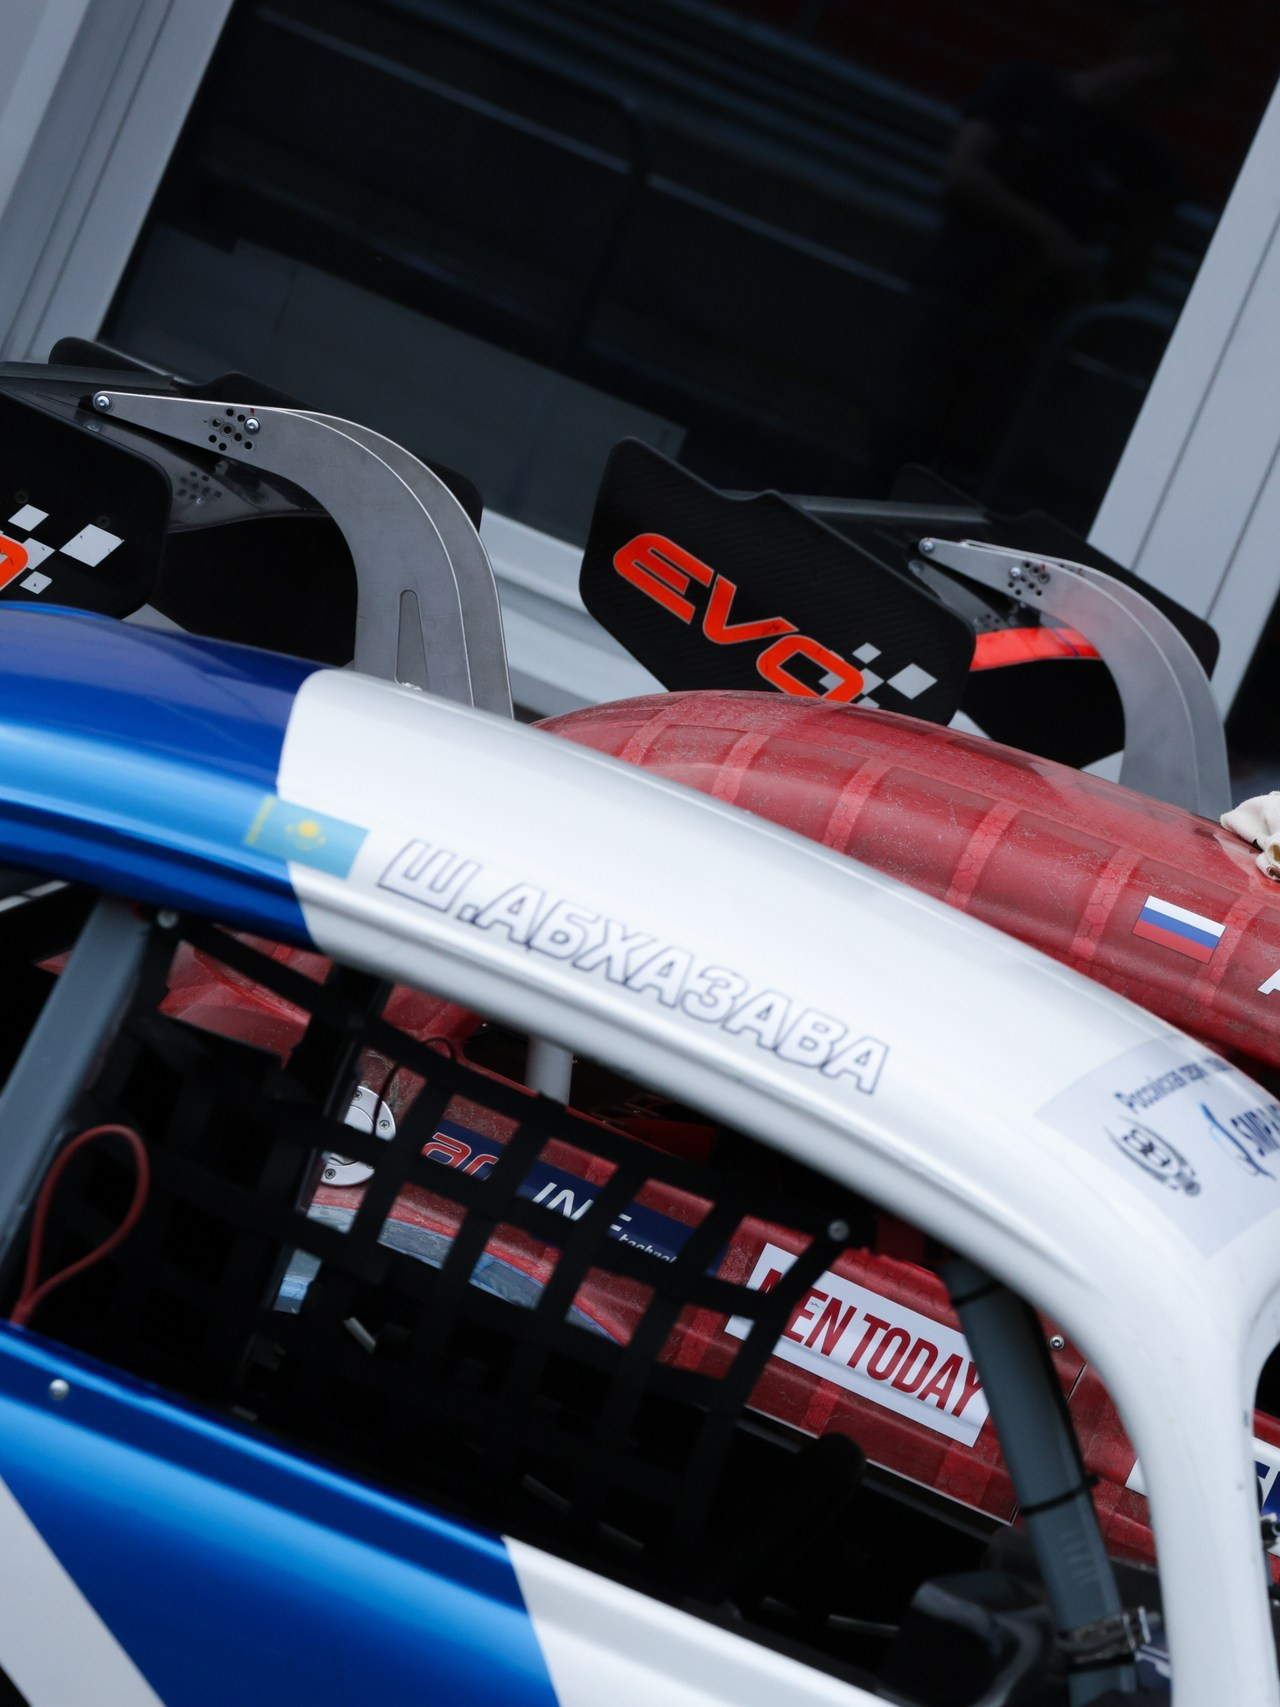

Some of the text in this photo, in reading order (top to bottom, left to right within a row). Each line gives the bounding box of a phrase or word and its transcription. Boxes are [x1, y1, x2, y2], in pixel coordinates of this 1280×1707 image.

[613, 532, 865, 702] EVO
[376, 839, 890, 1095] Ш.АБХАЗАВА
[846, 1312, 983, 1418] TODAY
